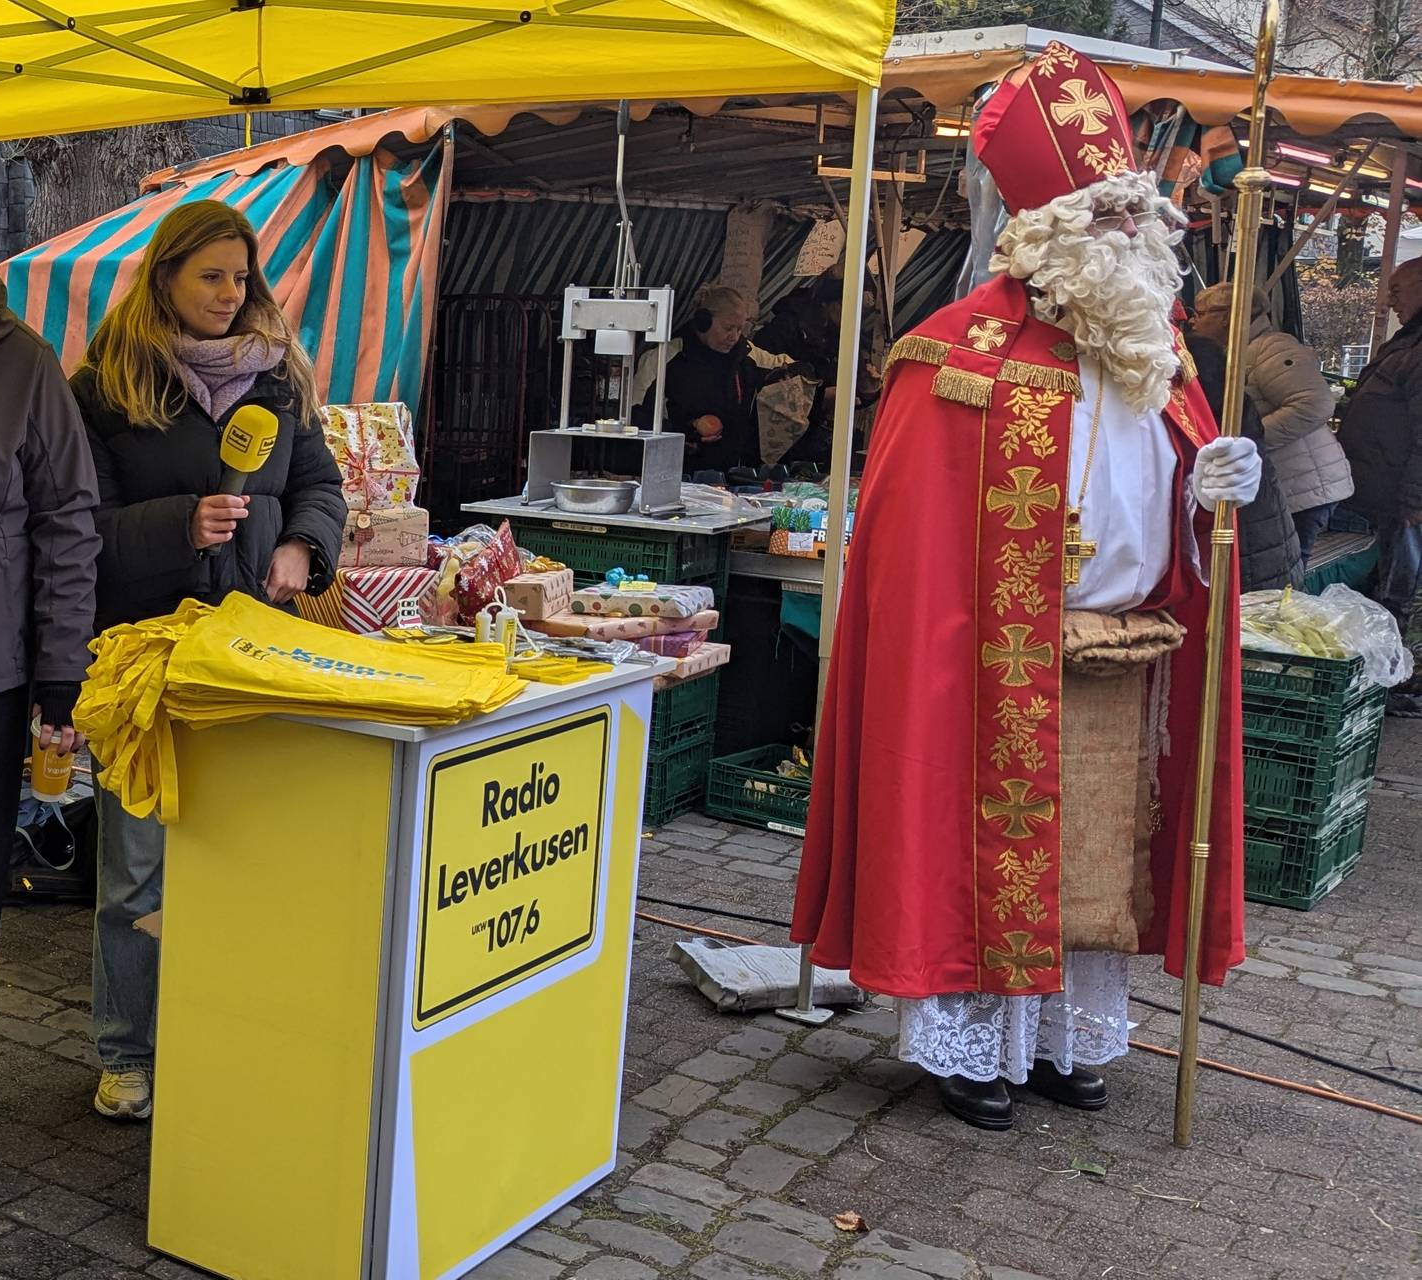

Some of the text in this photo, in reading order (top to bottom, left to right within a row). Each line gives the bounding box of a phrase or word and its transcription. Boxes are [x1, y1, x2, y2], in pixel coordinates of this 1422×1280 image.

[482, 762, 560, 828] Radio
[437, 823, 589, 911] Leverkusen
[471, 899, 541, 952] UKW 107,6
